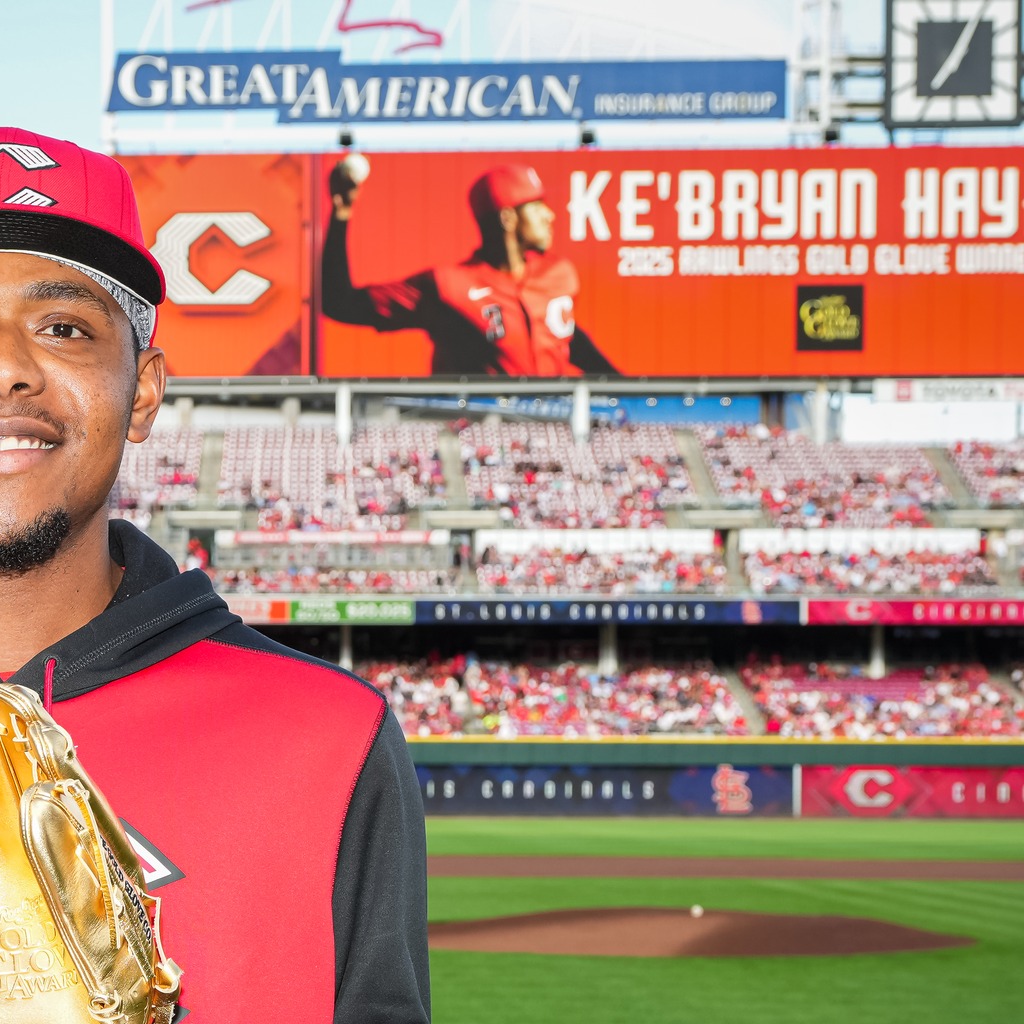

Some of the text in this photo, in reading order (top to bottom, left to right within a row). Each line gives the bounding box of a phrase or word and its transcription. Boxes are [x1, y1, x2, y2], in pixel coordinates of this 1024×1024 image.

[118, 55, 309, 107] GREAT
[594, 93, 706, 116] INSURANCE
[709, 91, 777, 115] GROUP
[568, 166, 1024, 241] KE'BRYAN HAY
[617, 246, 674, 276] 2025
[678, 244, 799, 276] RAWLINGS
[806, 244, 868, 275] GOLD
[875, 243, 950, 275] GLOVE
[481, 780, 655, 799] CARDINALS
[5, 968, 79, 999] AWAR
